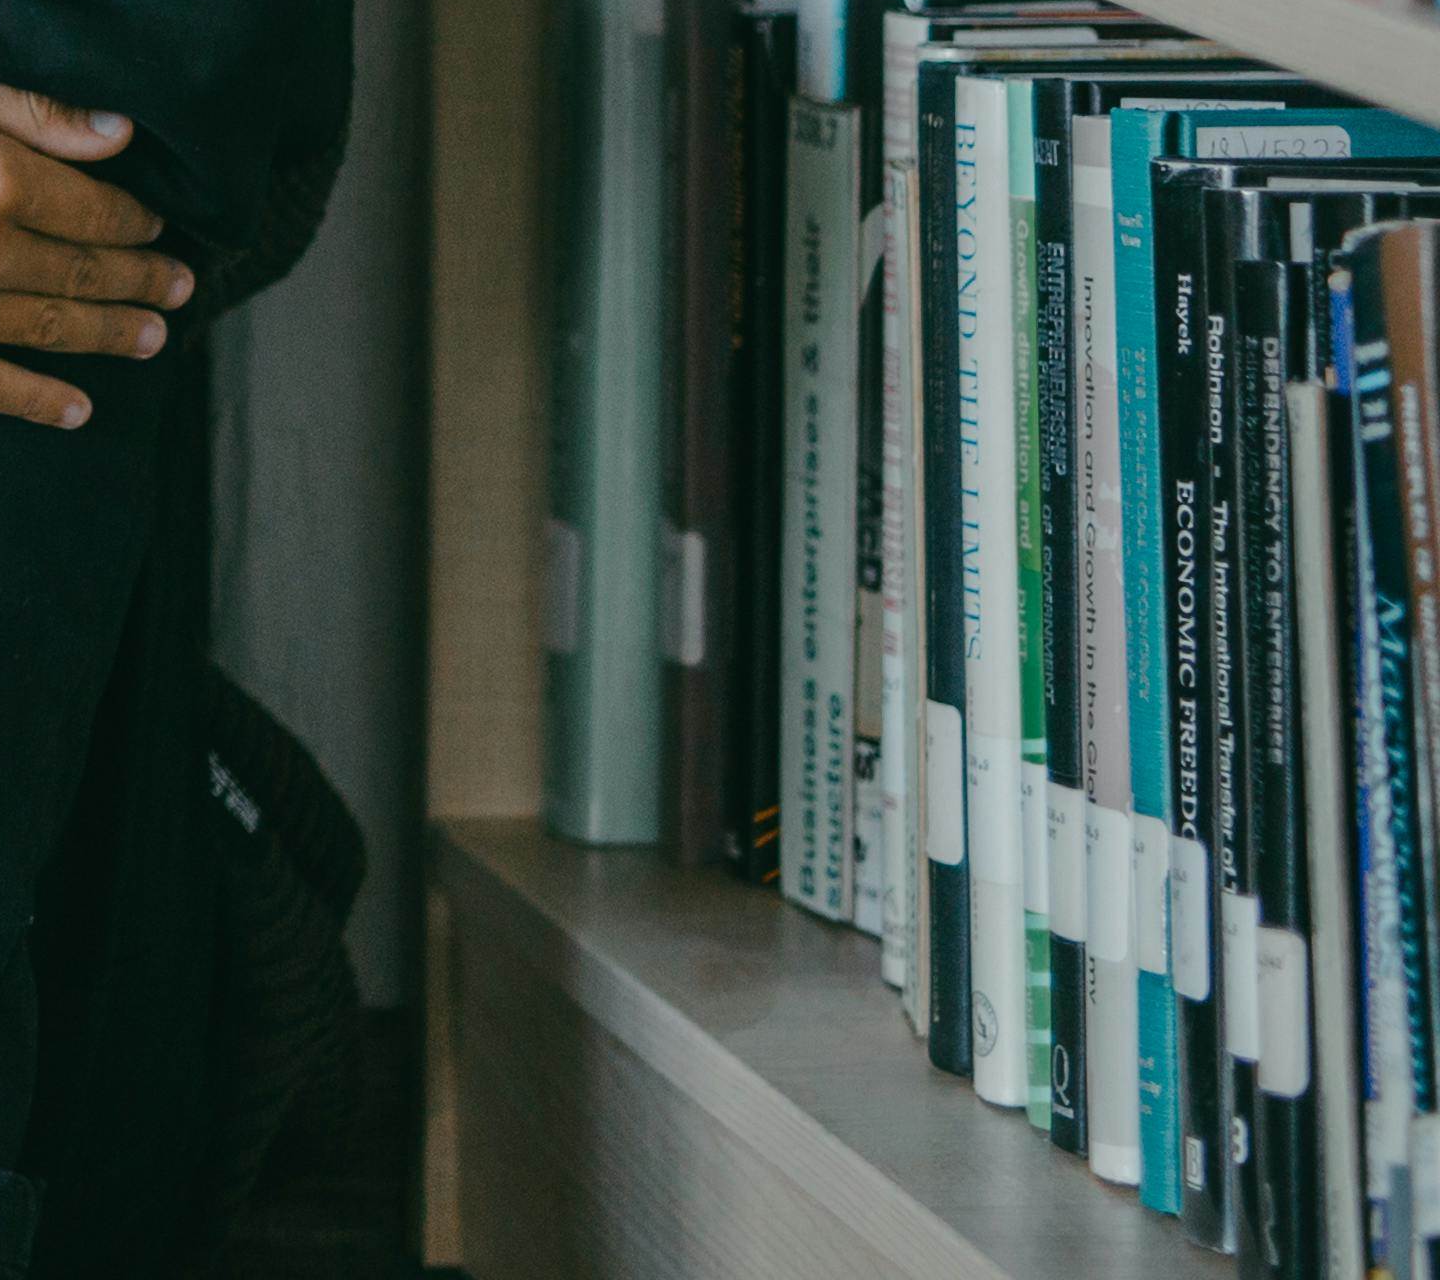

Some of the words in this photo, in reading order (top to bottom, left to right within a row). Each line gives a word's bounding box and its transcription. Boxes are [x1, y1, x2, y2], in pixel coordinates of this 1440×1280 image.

[957, 122, 979, 370] BEYOND
[1175, 273, 1192, 355] Hayek
[959, 380, 981, 466] THE
[1047, 240, 1067, 478] ENTREPRENEURSHIP
[1083, 274, 1095, 441] Innovation
[1208, 315, 1225, 443] Robinson
[1084, 450, 1097, 513] and
[1261, 337, 1282, 534] DEPENDENCY
[802, 394, 823, 656] enterprises
[962, 492, 983, 662] LIMITS
[1019, 500, 1032, 548] and
[1083, 522, 1097, 635] Growth
[1178, 480, 1195, 686] ECONOMIC
[1212, 500, 1228, 552] The
[1265, 540, 1282, 583] TO
[1043, 544, 1056, 704] GOVERNMENT
[1214, 560, 1236, 728] International
[1265, 590, 1284, 770] ENTERPRISE
[1085, 678, 1098, 734] the
[801, 675, 817, 901] Business
[1219, 734, 1238, 840] Transfer
[1222, 846, 1237, 876] of
